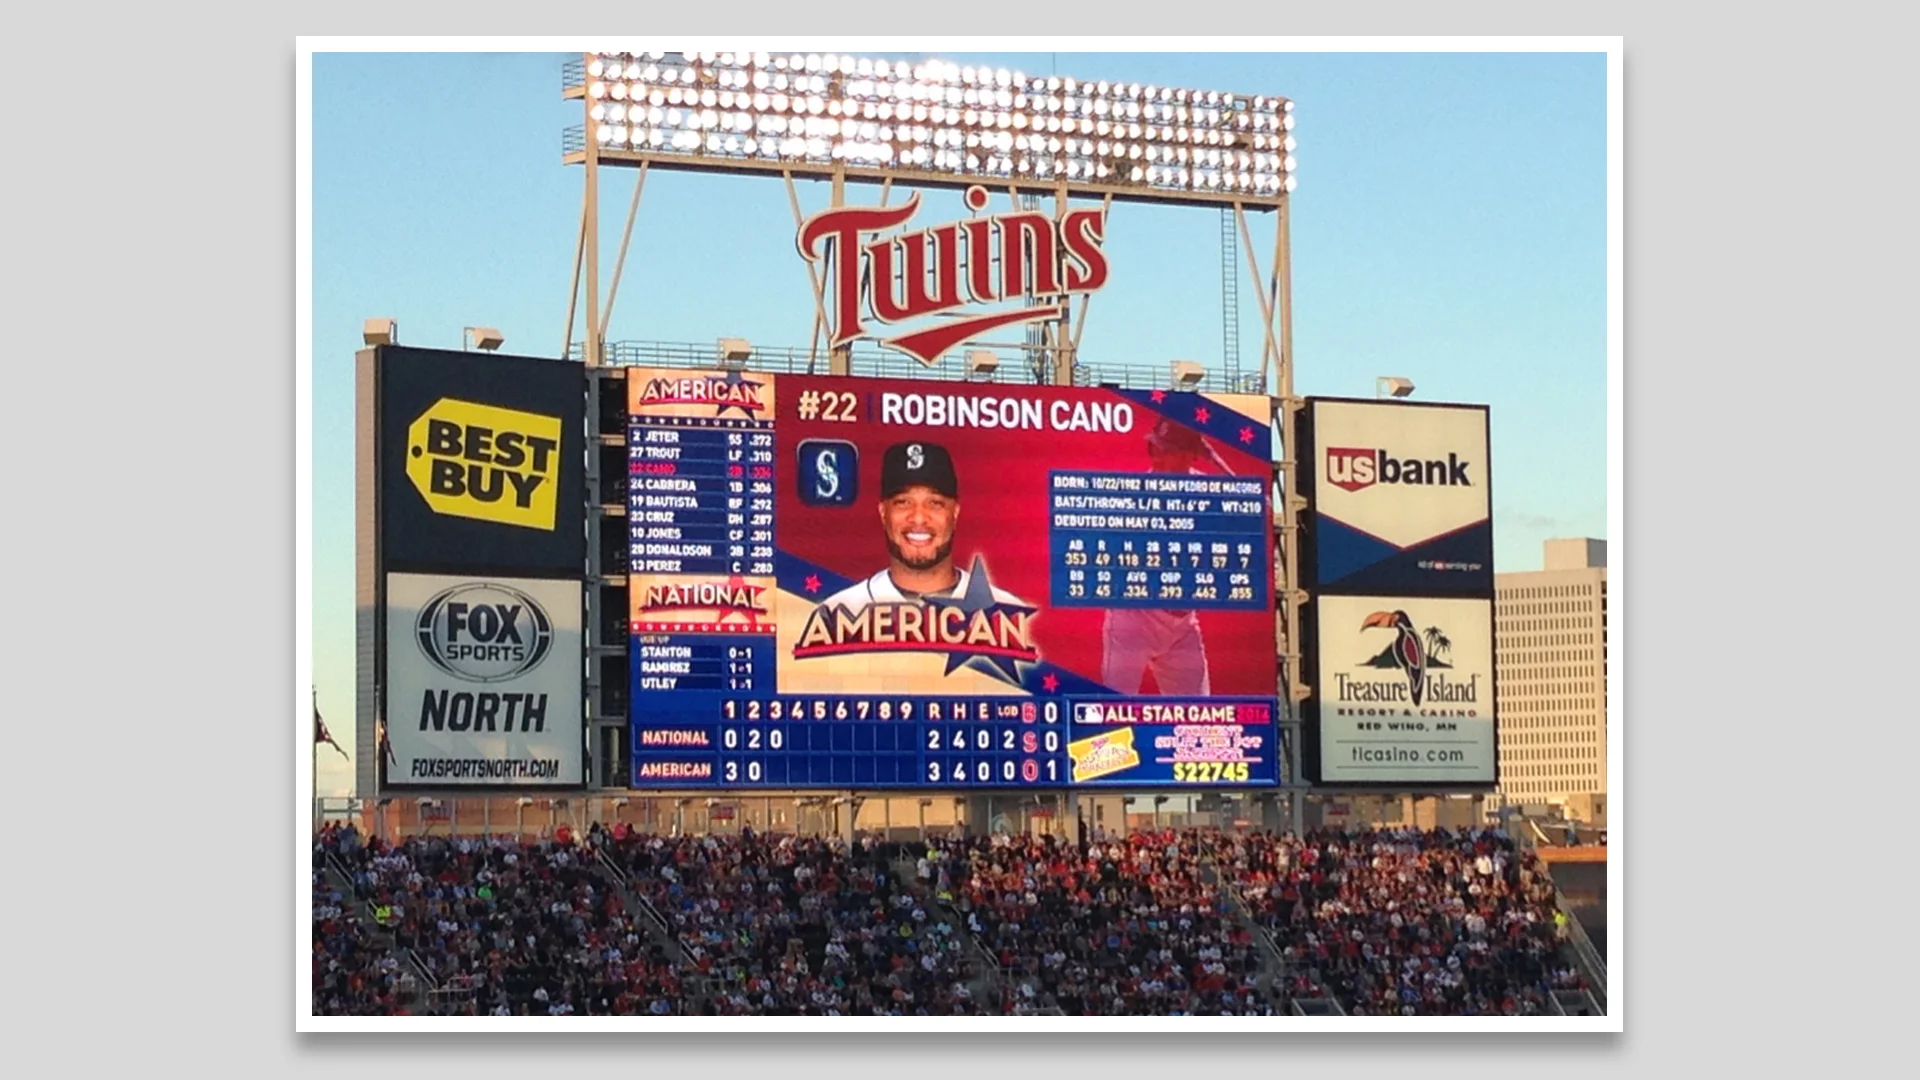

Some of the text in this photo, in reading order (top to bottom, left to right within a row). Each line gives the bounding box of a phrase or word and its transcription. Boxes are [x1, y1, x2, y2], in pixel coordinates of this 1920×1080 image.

[795, 184, 1112, 350] Twins
[643, 378, 761, 404] AMERICAN
[798, 391, 857, 421] #22
[881, 392, 1133, 433] ROBINSON CANO
[427, 418, 557, 473] BEST
[632, 430, 772, 447] 2 JETER SS .272
[631, 447, 772, 462] 27 TROUT LF .310
[430, 458, 544, 509] BUY
[631, 478, 644, 490] 24
[645, 479, 696, 491] CABRERA
[750, 483, 772, 494] .306
[1054, 475, 1089, 489] BORN:
[1144, 479, 1157, 491] IN
[1159, 479, 1177, 491] SAN
[1179, 480, 1207, 493] PEDRO
[1209, 481, 1221, 493] DE
[631, 496, 644, 507] 19
[645, 496, 698, 508] BAUTISTA
[750, 499, 772, 510] .292
[1054, 495, 1136, 510] BATS/THROWS:
[1138, 497, 1160, 511] L/R
[1166, 499, 1185, 511] HT:
[646, 511, 674, 523] CRUZ
[728, 513, 743, 525] DH
[1054, 515, 1106, 527] DEBUTED
[1107, 516, 1123, 528] ON
[1125, 516, 1149, 529] MAY
[1169, 518, 1195, 530] 2005
[631, 527, 772, 541] 10 JONES CF .301
[631, 544, 645, 555] 20
[646, 545, 711, 557] DONALDSON
[730, 546, 743, 557] 3B
[1069, 539, 1084, 551] AB
[1098, 539, 1106, 551] R
[1124, 540, 1132, 551] H
[631, 560, 644, 571] 13
[646, 560, 681, 572] PEREZ
[732, 562, 741, 573] C
[1065, 552, 1248, 569] 353 49 118 22 1 7 57 7
[1229, 573, 1249, 585] OPS
[647, 583, 763, 608] NATIONAL
[1069, 584, 1084, 596] 33
[1095, 584, 1111, 596] 45
[447, 602, 523, 645] FOX
[801, 603, 1030, 650] AMERICAN
[446, 644, 525, 661] SPORTS
[641, 646, 691, 658] STANTON
[641, 662, 691, 673] RAMIREZ
[641, 678, 677, 689] UTLEY
[1334, 673, 1477, 702] Treasure Island
[419, 689, 548, 732] NORTH
[725, 701, 735, 719] 1
[748, 701, 760, 719] 2
[770, 701, 782, 719] 3
[791, 701, 804, 719] 4
[814, 702, 826, 719] 5
[835, 702, 848, 719] 6
[857, 702, 869, 719] 7
[879, 702, 891, 719] 8
[900, 702, 912, 719] 9
[929, 703, 940, 719] R
[954, 703, 966, 719] H
[979, 703, 989, 719] E
[1045, 702, 1057, 723] 0
[1105, 705, 1136, 722] ALL
[1143, 705, 1184, 722] STAR
[1188, 705, 1236, 722] GAME
[1337, 708, 1477, 717] RESORT & CASINO
[1357, 722, 1381, 731] RED
[1436, 722, 1457, 731] MN
[642, 730, 709, 746] NATIONAL
[725, 730, 737, 748] 0
[748, 730, 760, 748] 2
[770, 730, 782, 748] 0
[929, 730, 940, 748] 2
[953, 730, 965, 749] 4
[978, 730, 989, 749] 0
[1003, 730, 1015, 749] 2
[1045, 731, 1058, 752] 0
[1352, 746, 1464, 762] ticasino.com
[412, 758, 560, 778] FOXSPORTSNORTH.COM
[640, 762, 711, 777] AMERICAN
[725, 762, 738, 781] 3
[748, 762, 760, 781] 0
[929, 762, 940, 781] 3
[953, 762, 966, 781] 4
[978, 762, 990, 781] 0
[1004, 761, 1015, 780] 0
[1047, 759, 1056, 781] 1
[1174, 762, 1249, 782] $22745
